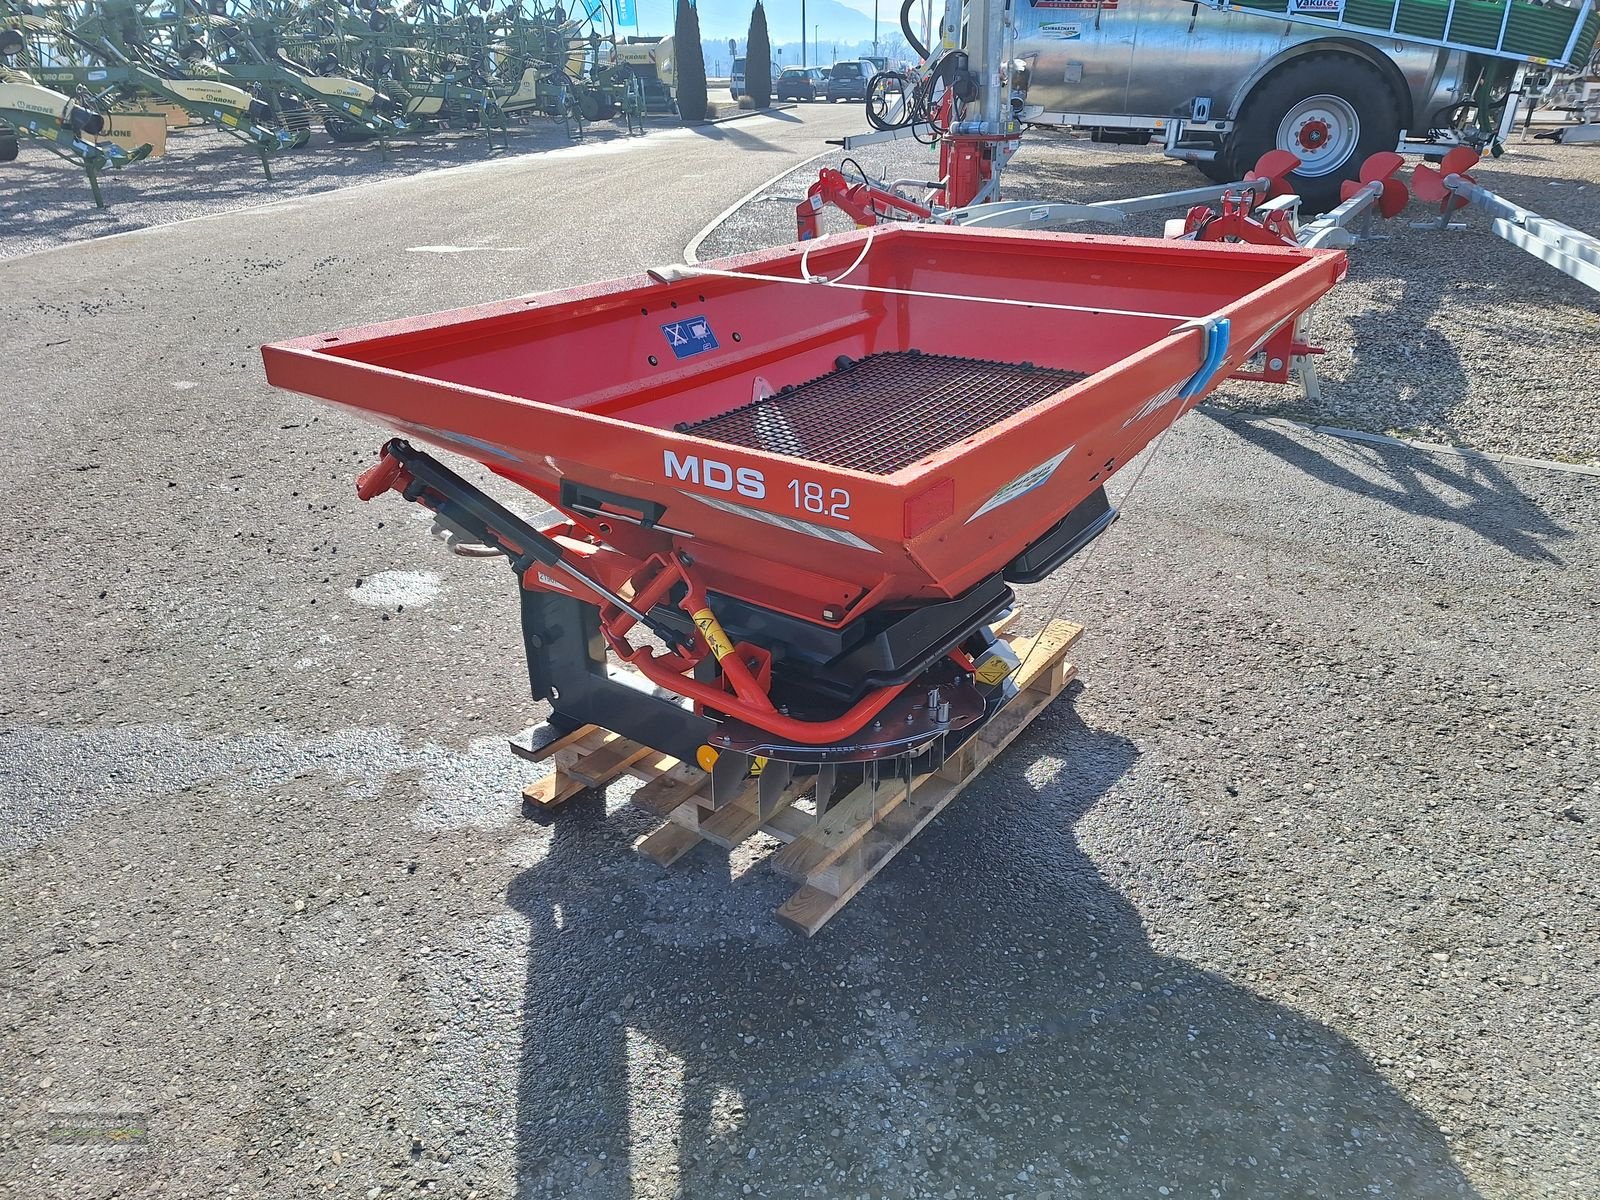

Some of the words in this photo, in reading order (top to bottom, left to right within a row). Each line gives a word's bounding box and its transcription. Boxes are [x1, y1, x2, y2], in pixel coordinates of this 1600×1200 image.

[213, 96, 236, 104] KRONE
[25, 104, 54, 113] KRONE
[663, 450, 766, 499] MDS
[787, 479, 850, 520] 18.2
